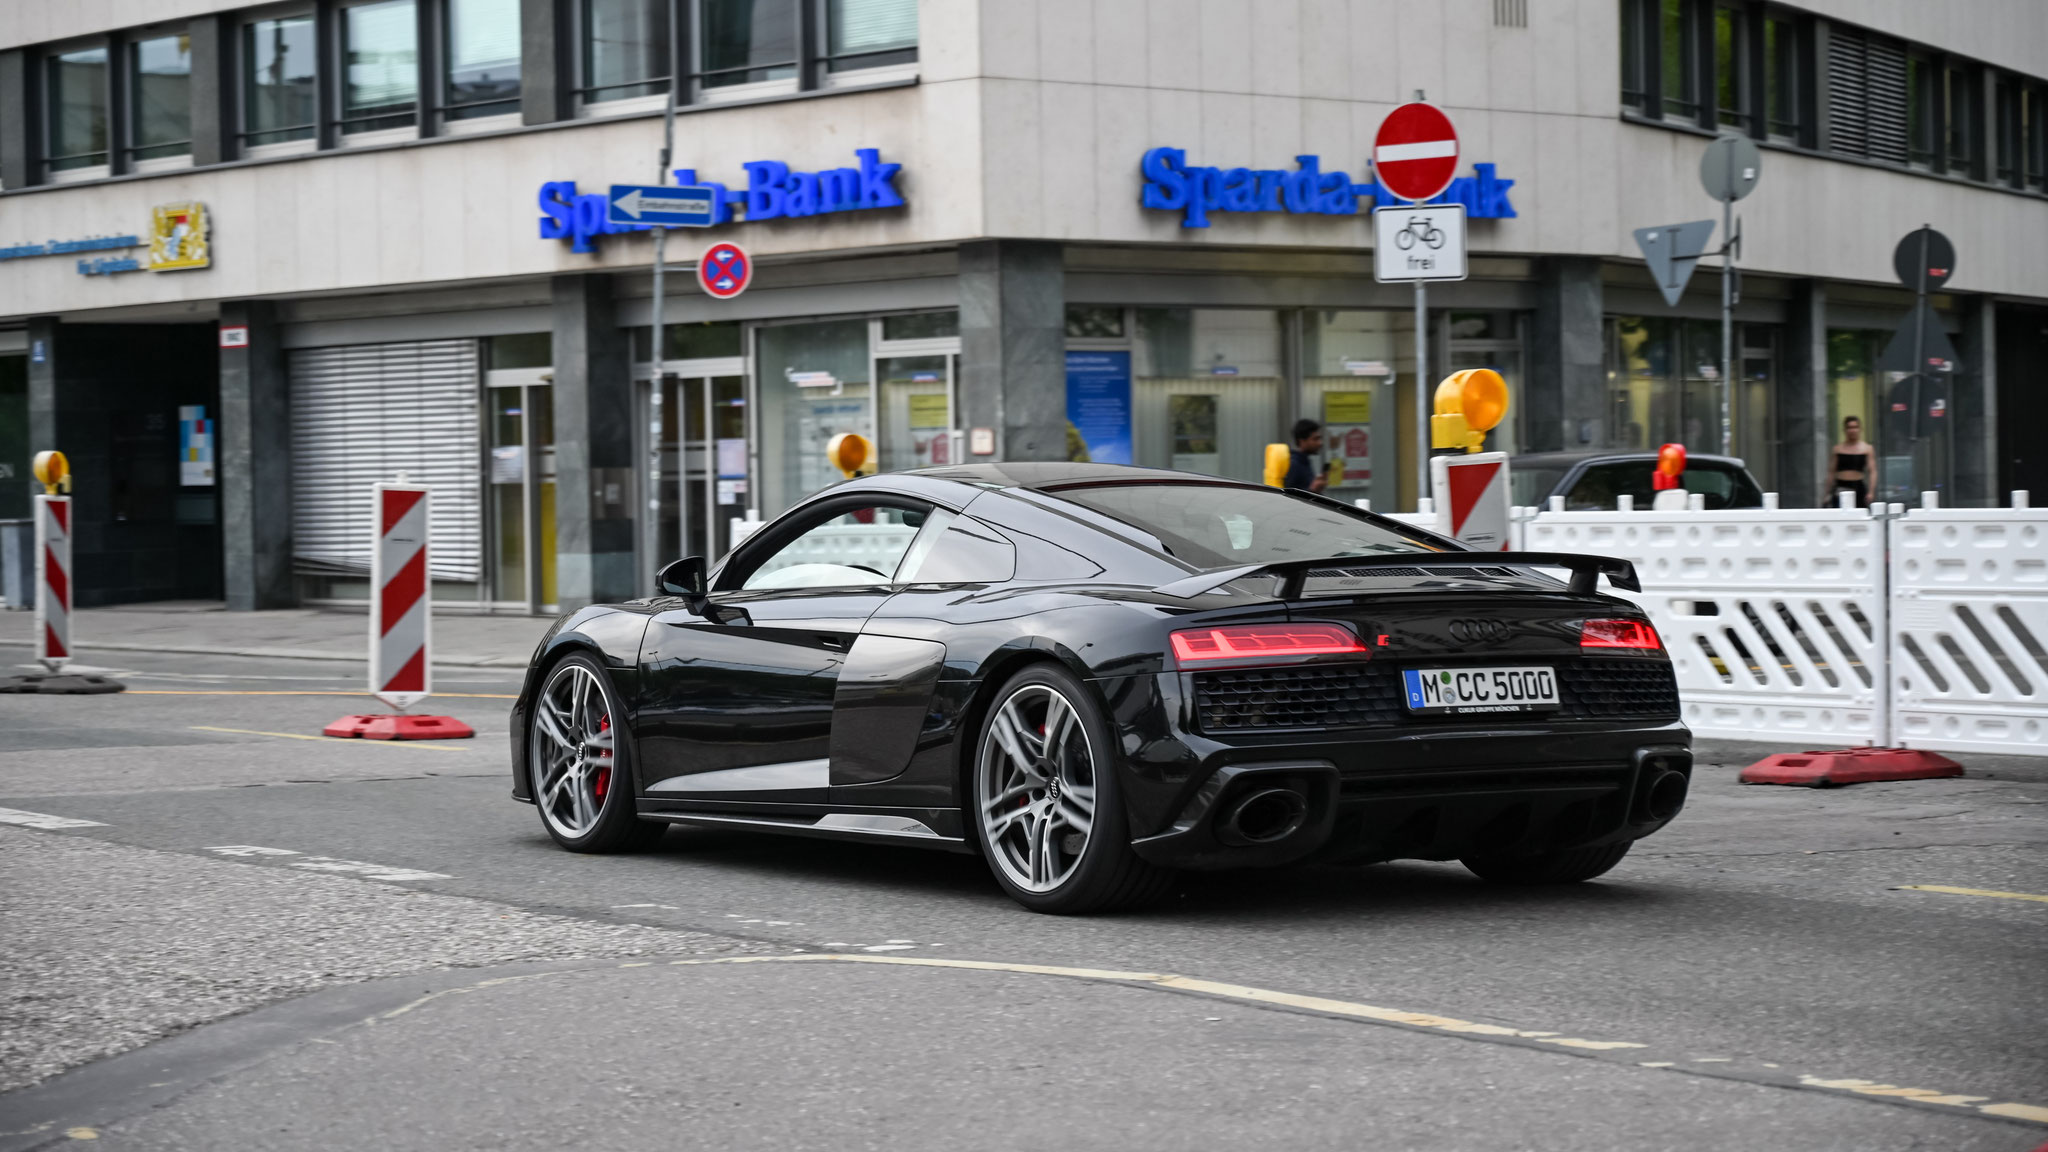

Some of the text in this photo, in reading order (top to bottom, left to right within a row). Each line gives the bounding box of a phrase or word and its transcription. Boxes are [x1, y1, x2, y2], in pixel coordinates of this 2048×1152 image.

[539, 148, 904, 253] Sp-Bank
[1142, 147, 1517, 228] Sparda-nk
[1407, 254, 1436, 270] frei
[1421, 673, 1441, 703] M
[1456, 672, 1490, 701] CC
[1492, 671, 1554, 700] 5000
